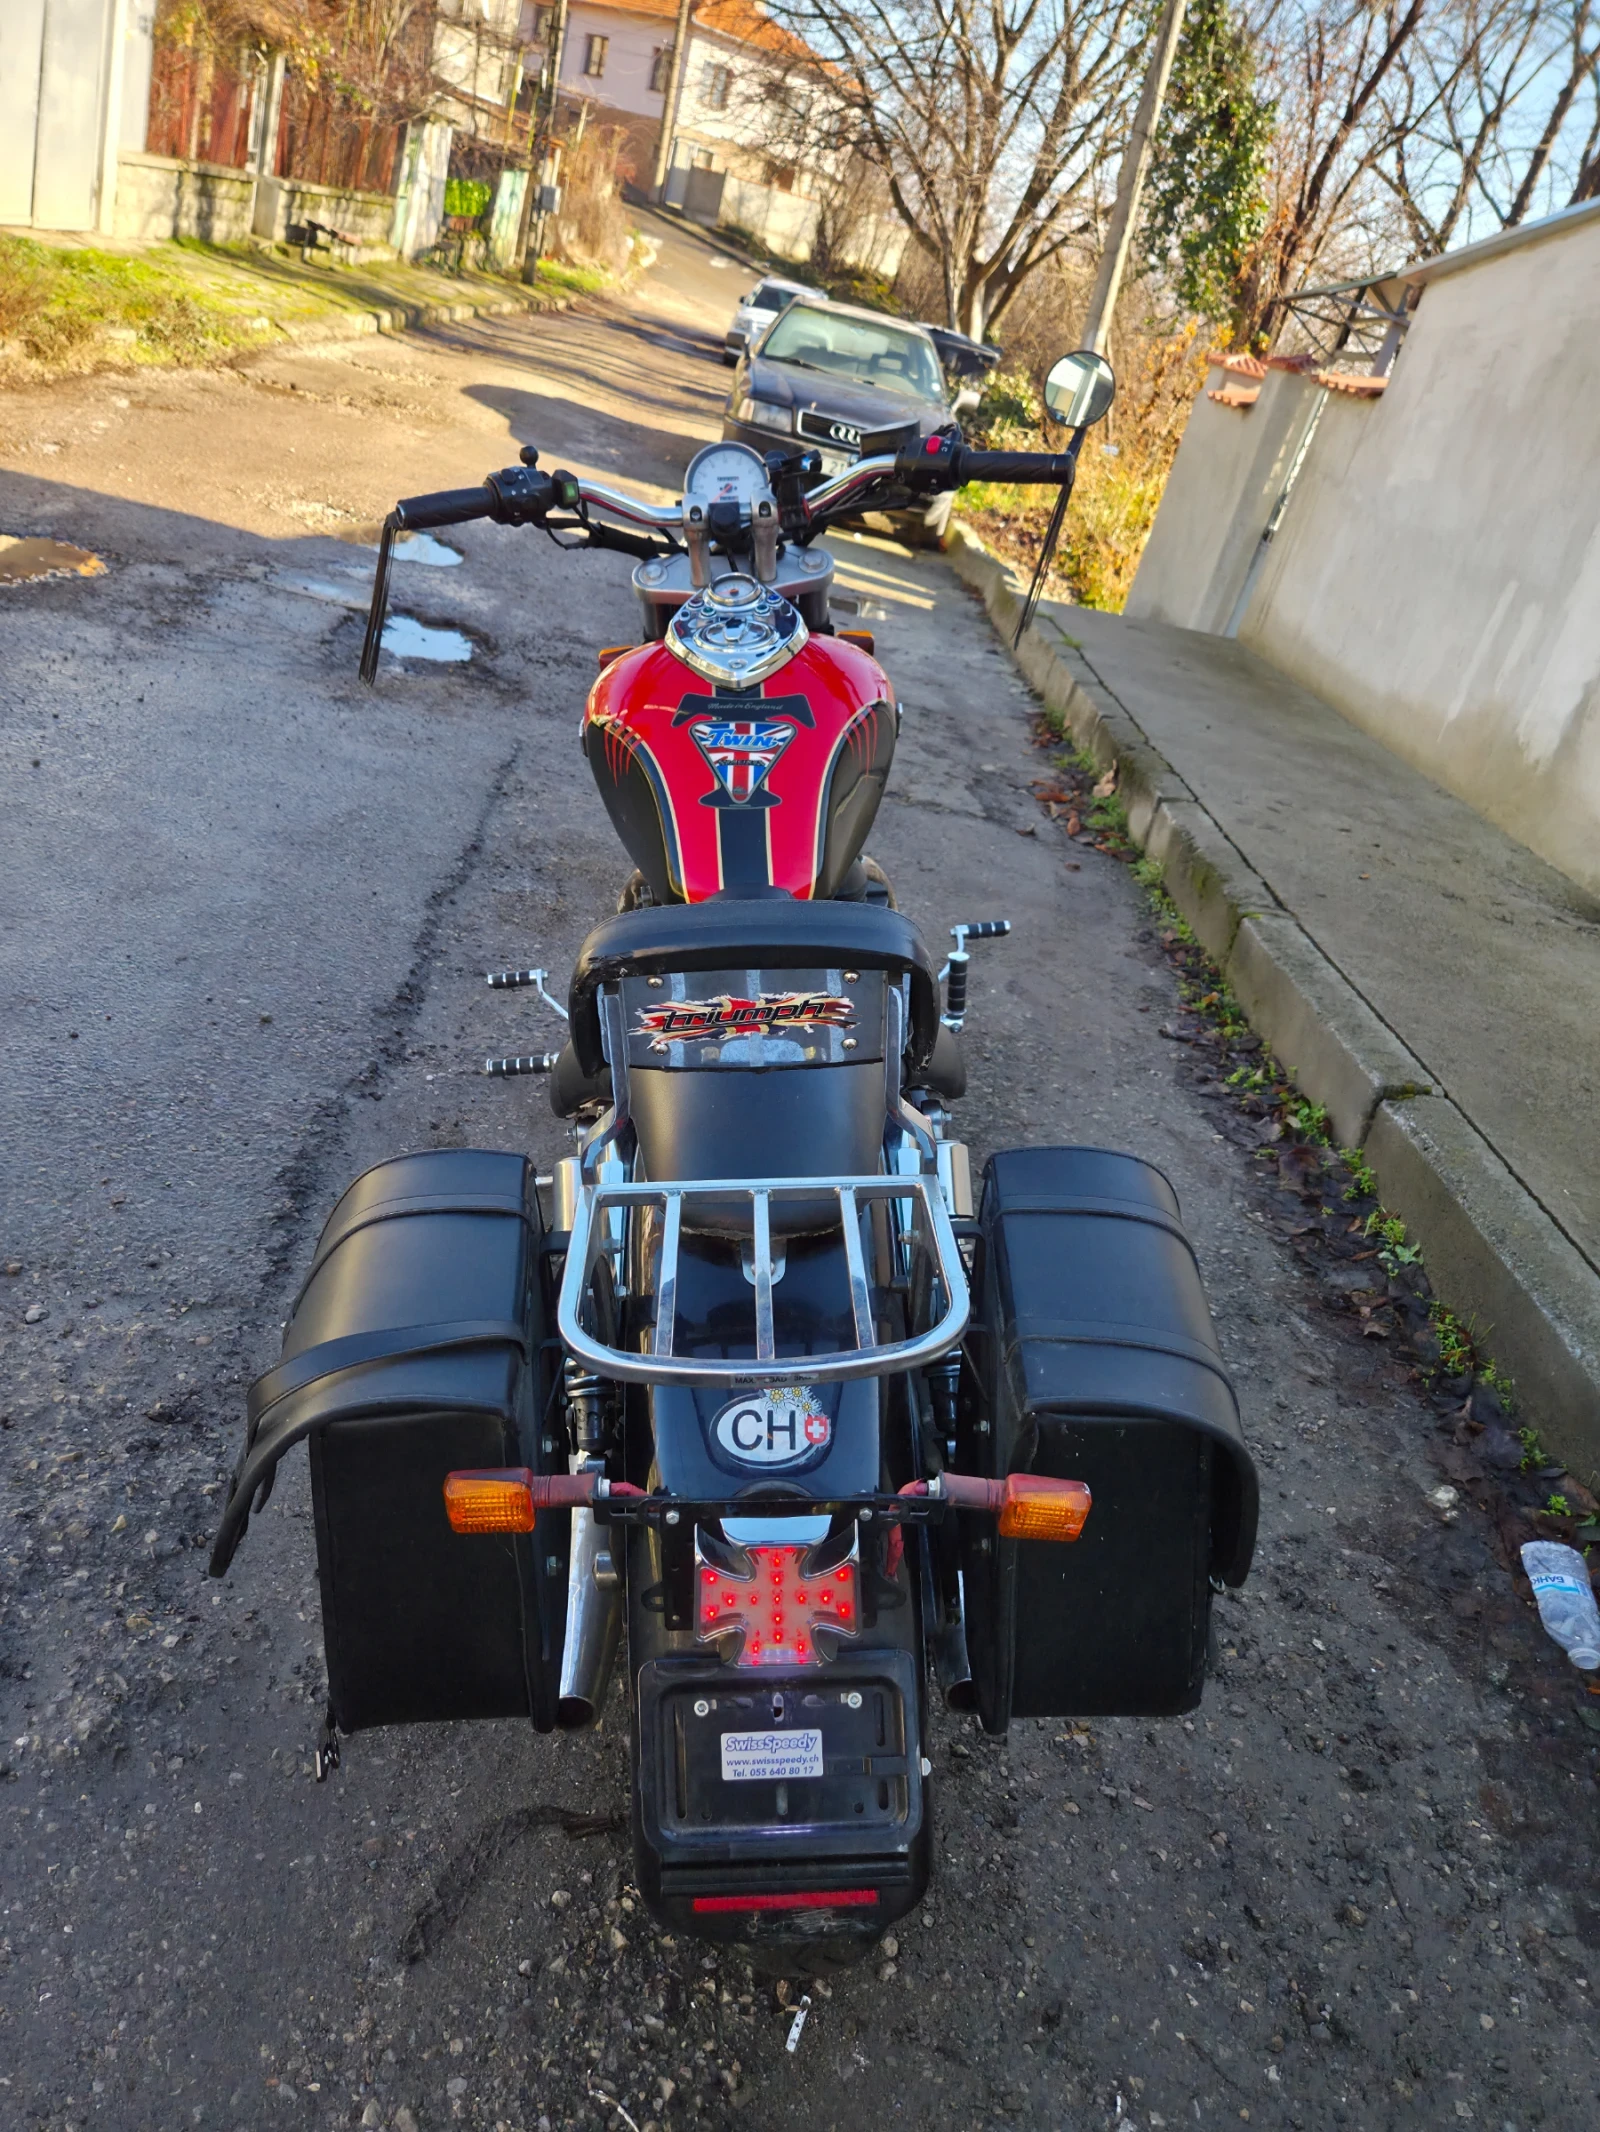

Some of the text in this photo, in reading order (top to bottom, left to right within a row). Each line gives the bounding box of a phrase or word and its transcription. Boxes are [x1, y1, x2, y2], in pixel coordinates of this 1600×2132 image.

[707, 702, 734, 710] Made
[744, 702, 784, 711] England
[731, 1409, 796, 1451] CH
[725, 1733, 818, 1753] SwissSpeedy
[726, 1754, 819, 1766] www.swissspeedy.ch
[732, 1766, 814, 1778] Tel. 055 640 80 17
